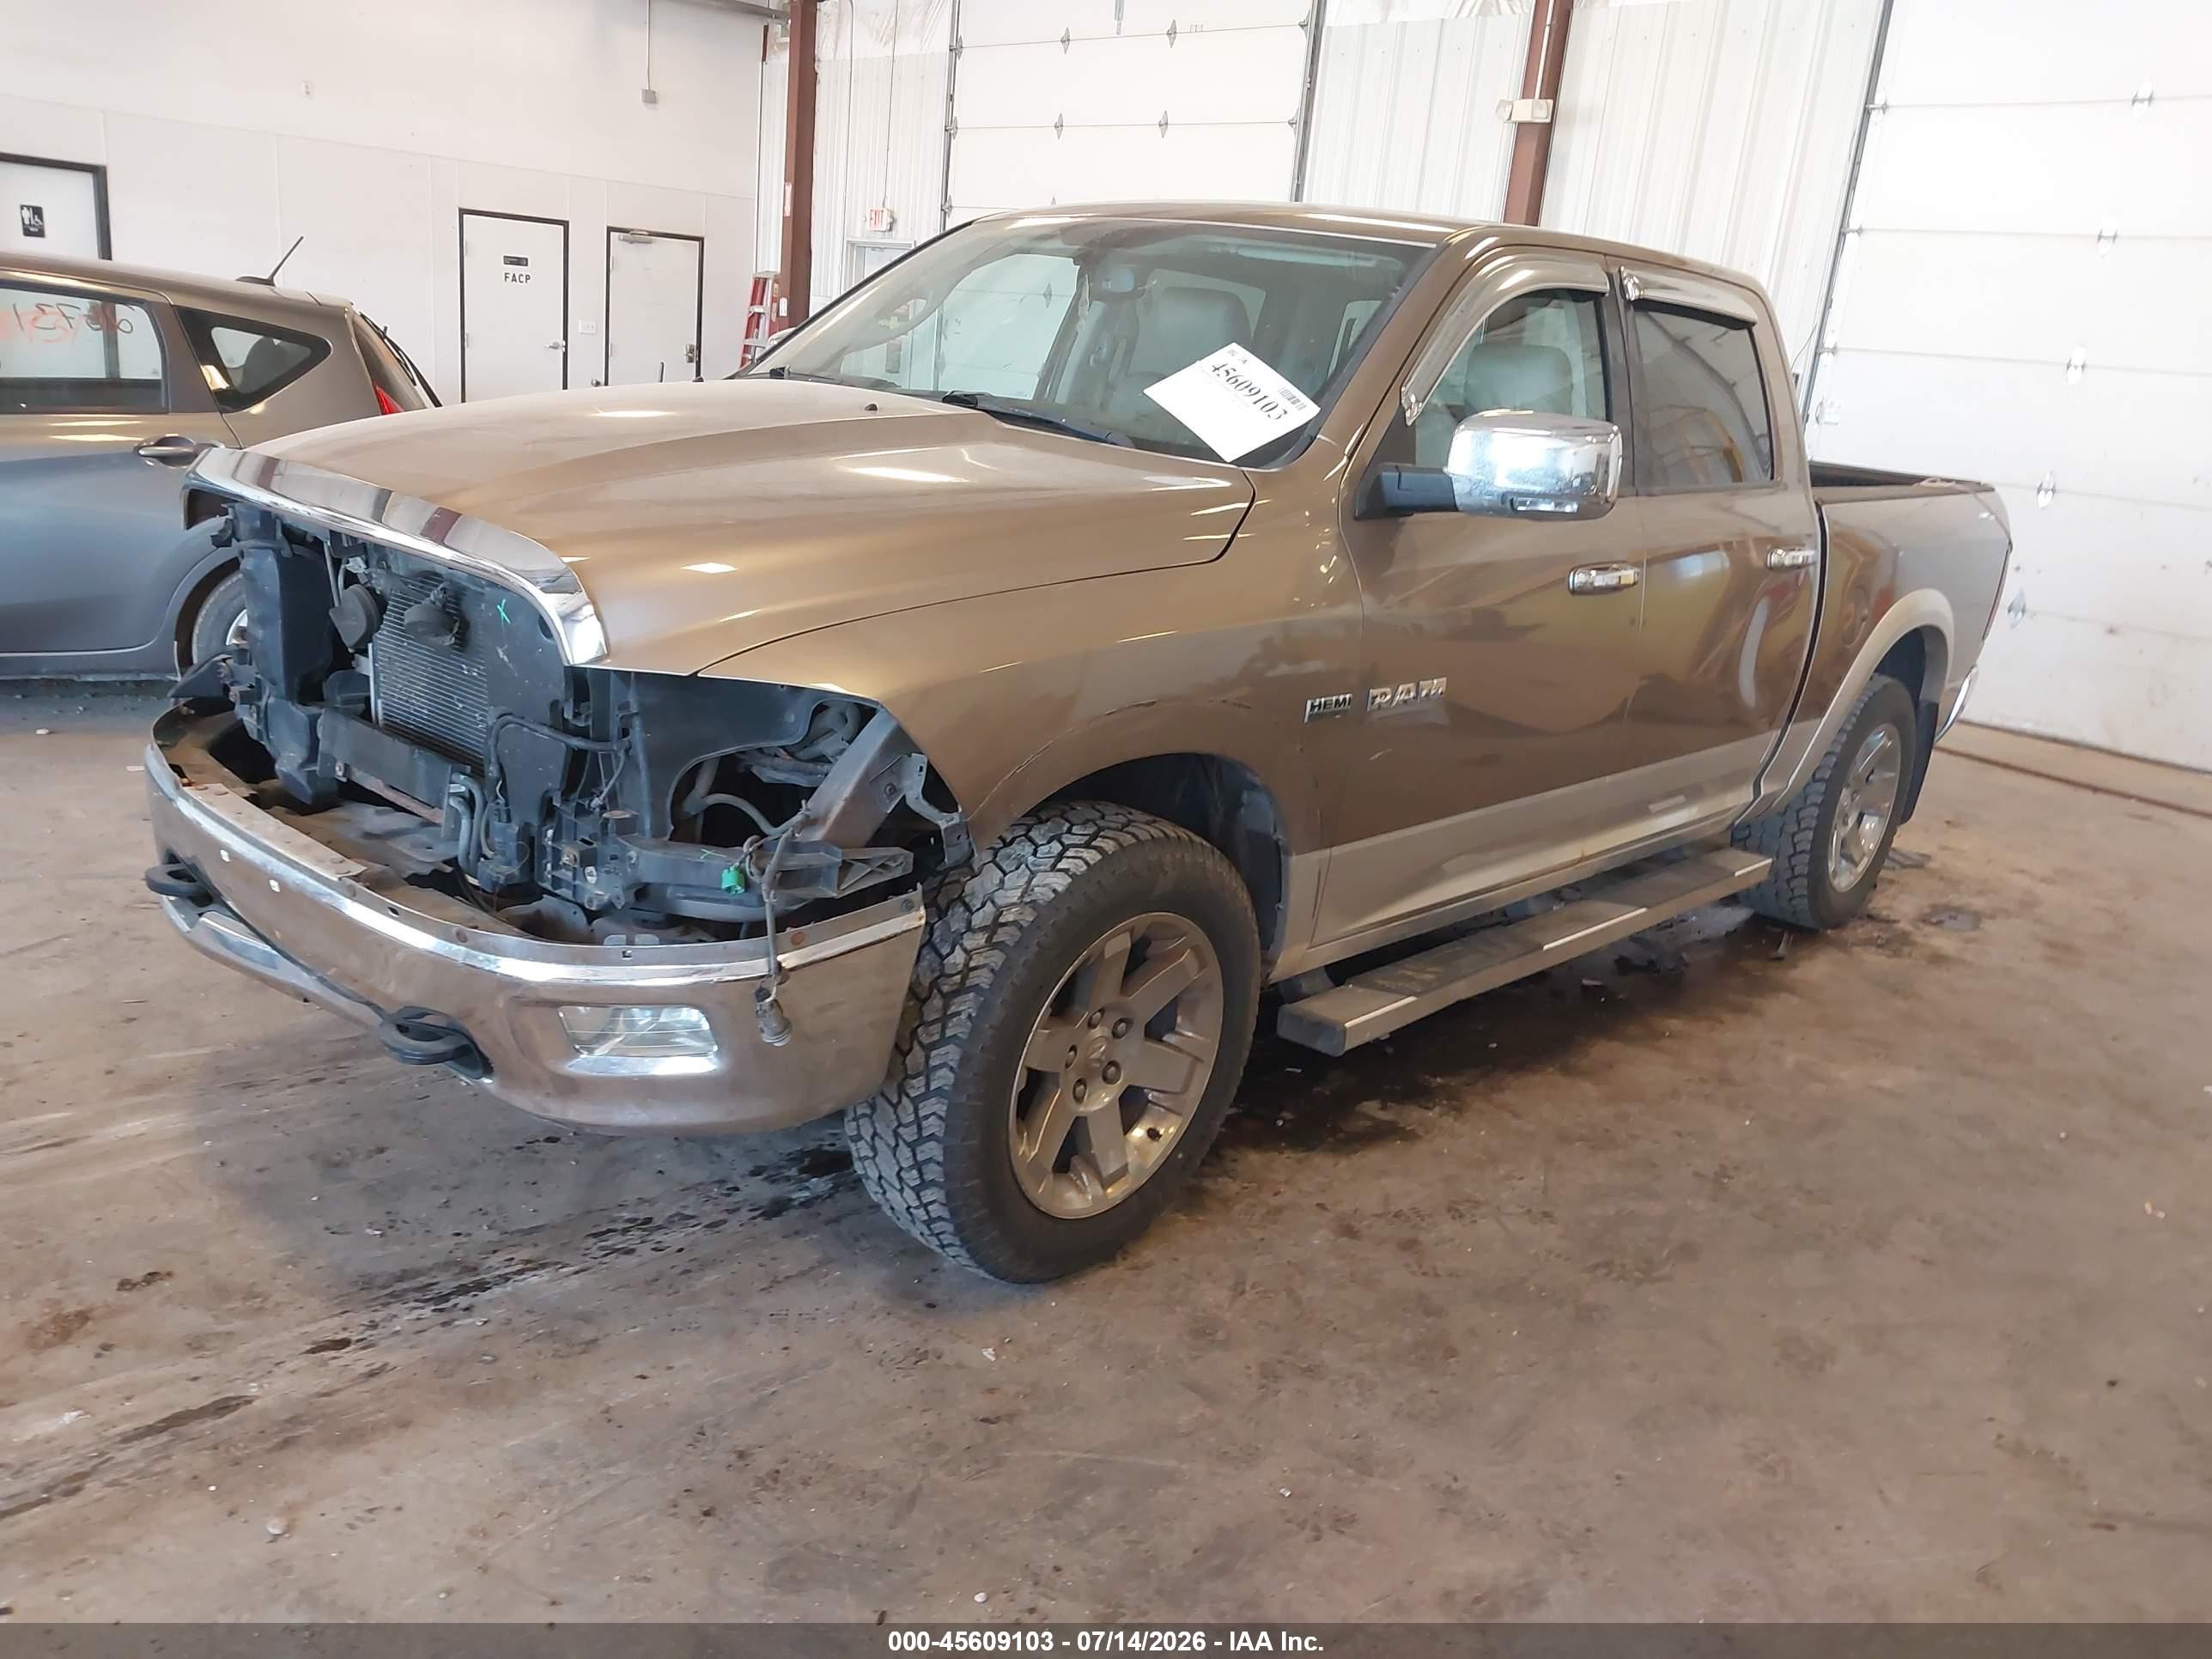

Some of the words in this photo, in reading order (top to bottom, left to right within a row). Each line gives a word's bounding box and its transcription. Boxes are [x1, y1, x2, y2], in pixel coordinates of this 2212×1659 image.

[504, 272, 531, 284] FACP
[1212, 362, 1288, 420] 45609103
[1307, 694, 1352, 714] HEMI
[1367, 677, 1448, 712] RAM
